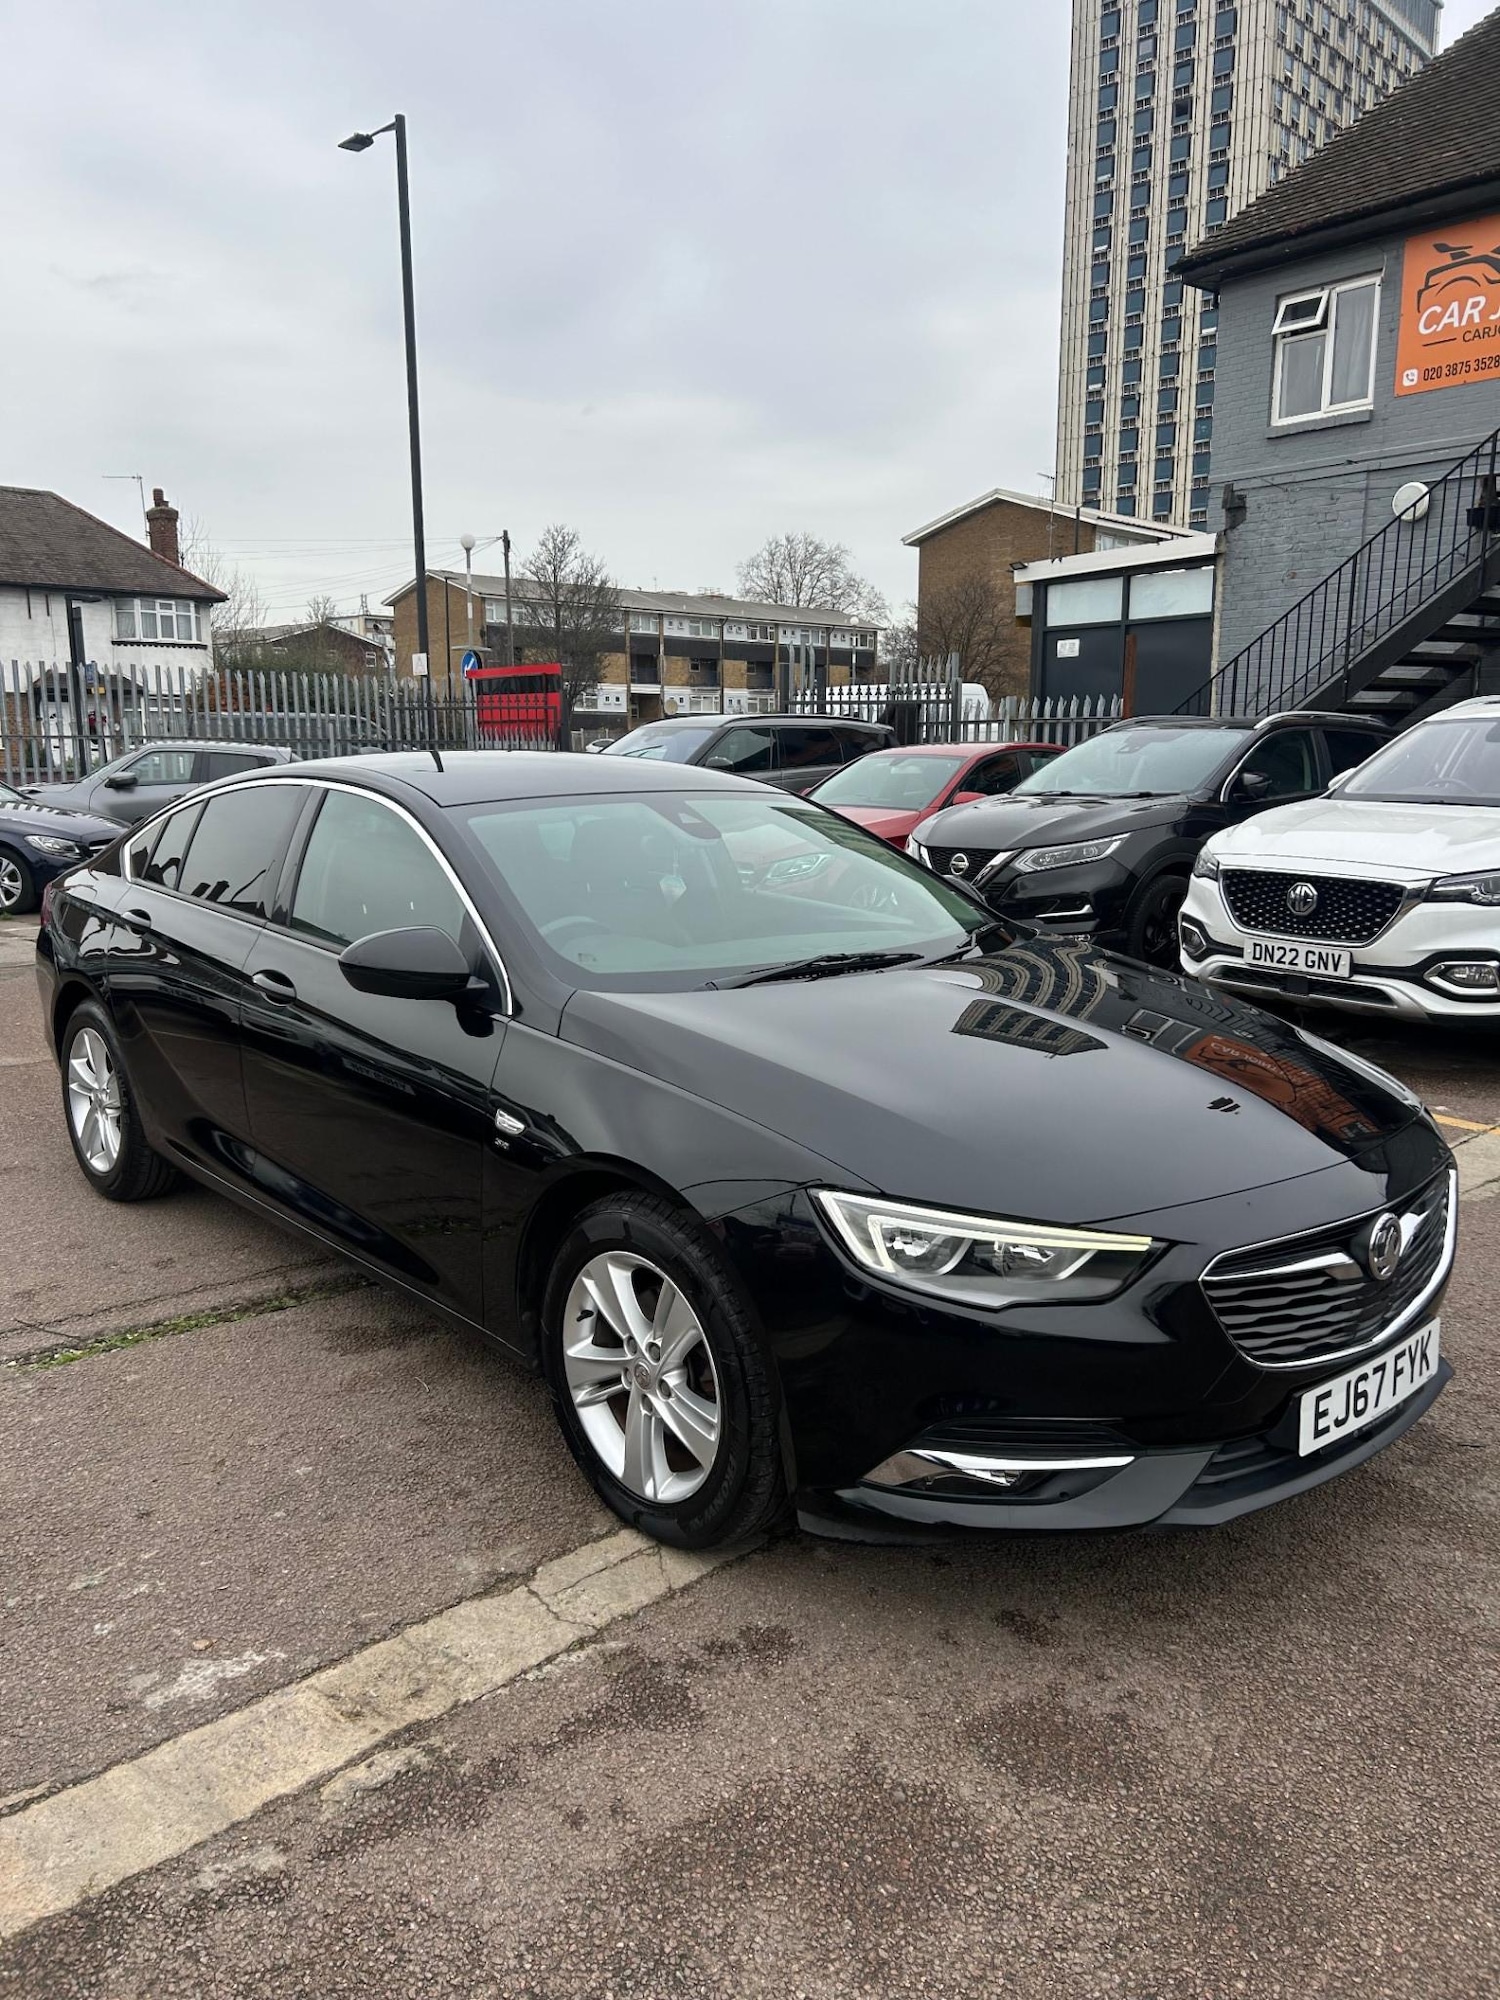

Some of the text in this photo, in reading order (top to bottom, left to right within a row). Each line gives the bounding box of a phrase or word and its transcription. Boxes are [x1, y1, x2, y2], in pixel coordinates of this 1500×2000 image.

[1418, 295, 1486, 335] CAR
[1423, 355, 1500, 382] 020 3875 3528
[1252, 942, 1342, 972] DN22 GNV
[1313, 1330, 1432, 1440] EJ67 FYK
